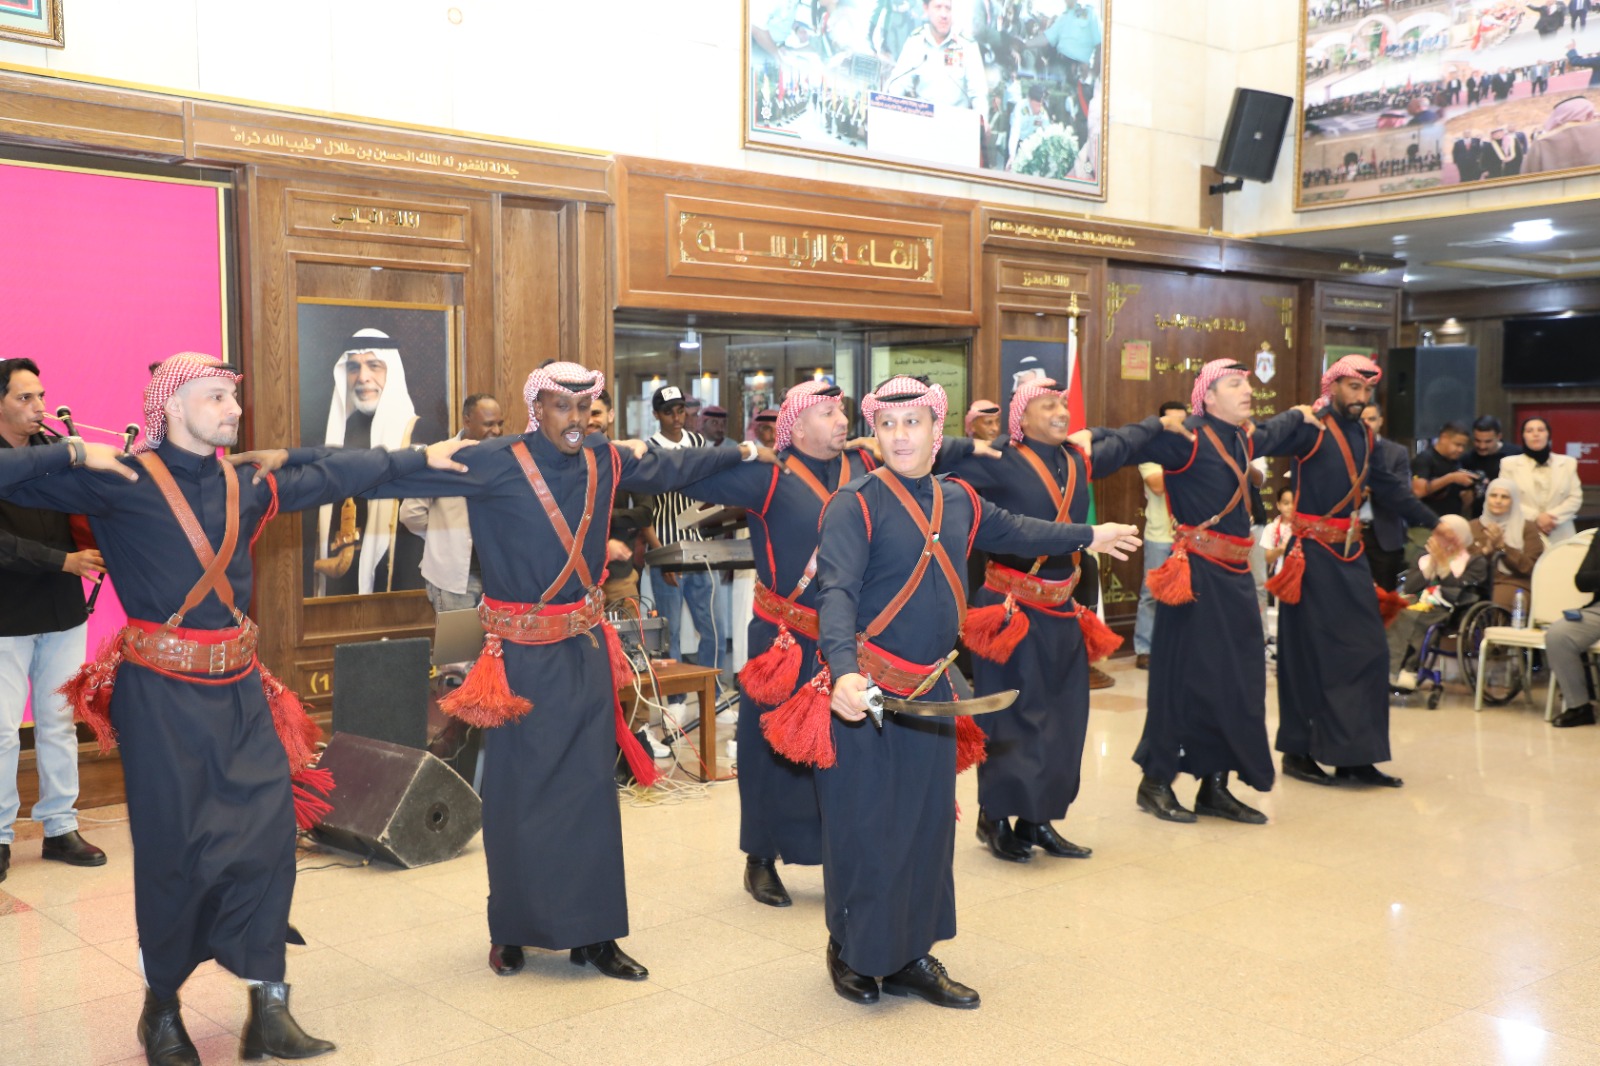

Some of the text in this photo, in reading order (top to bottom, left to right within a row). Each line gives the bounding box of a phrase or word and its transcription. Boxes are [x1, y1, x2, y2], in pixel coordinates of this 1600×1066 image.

[262, 133, 283, 147] الله
[324, 140, 355, 156] طلال
[356, 146, 372, 160] بن
[373, 147, 415, 163] الحسين
[415, 152, 440, 166] الملك
[442, 155, 454, 167] له
[456, 159, 488, 172] المغفور
[488, 161, 519, 179] جلالة
[331, 207, 420, 230] الملك الباني
[696, 222, 918, 271] القاعة الرئيسية
